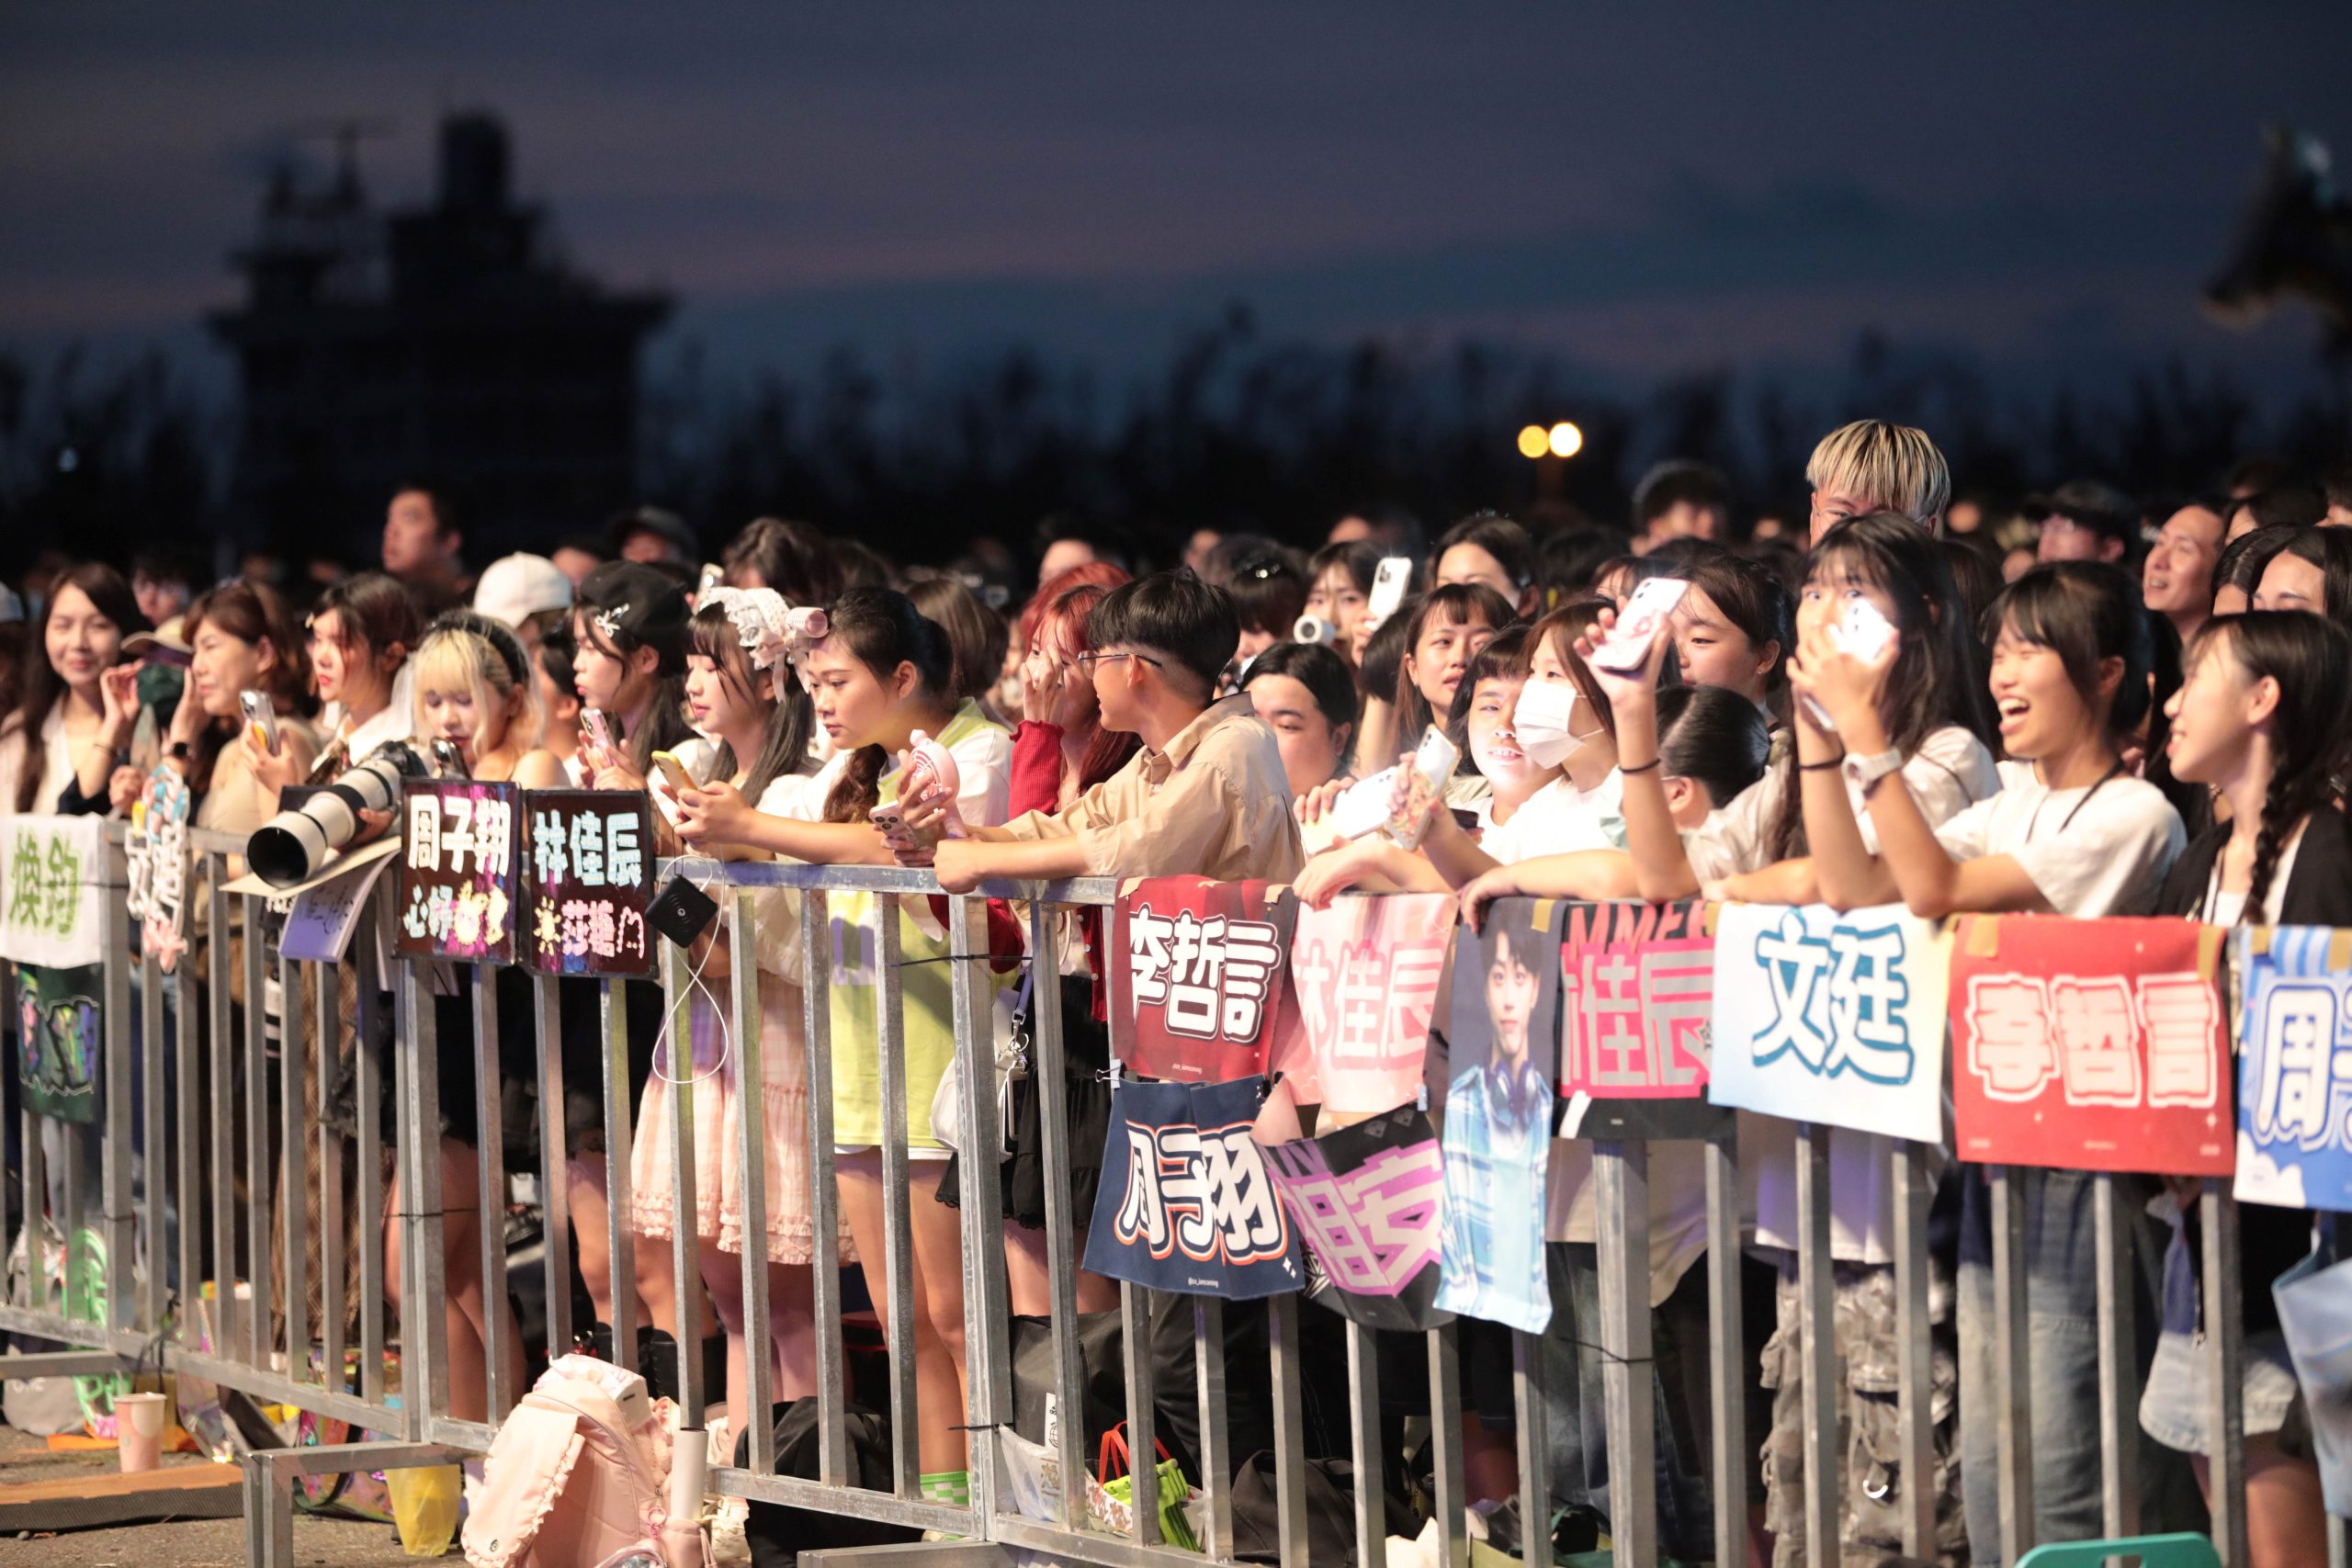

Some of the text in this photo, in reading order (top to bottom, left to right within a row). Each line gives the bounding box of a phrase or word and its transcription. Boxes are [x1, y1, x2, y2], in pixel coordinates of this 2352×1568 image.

[408, 793, 512, 876] 周子翔
[533, 809, 643, 887] 林佳辰
[1129, 905, 1279, 1043] 李哲言
[1752, 908, 1916, 1086] 文廷
[1964, 971, 2221, 1108] 李哲言
